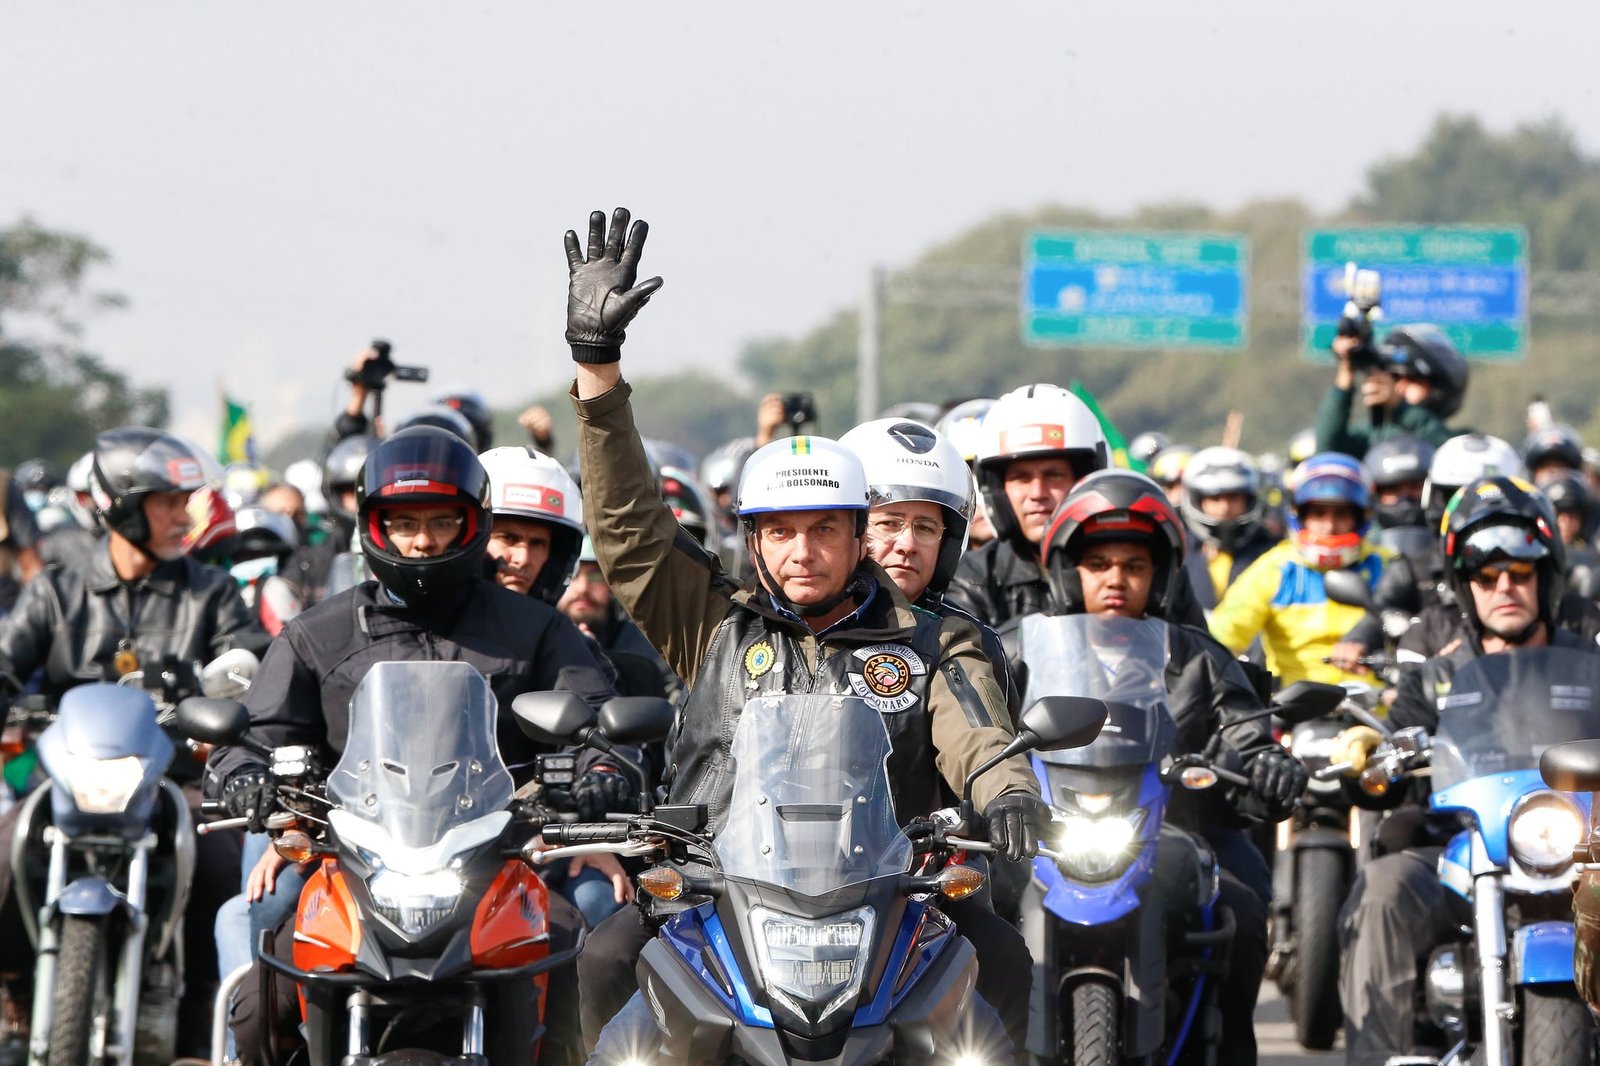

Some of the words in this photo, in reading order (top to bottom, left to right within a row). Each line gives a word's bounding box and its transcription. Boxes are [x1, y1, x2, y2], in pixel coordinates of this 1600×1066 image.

[896, 458, 940, 469] HONDA
[775, 468, 830, 478] PRESIDENTE
[786, 478, 840, 489] BOLSONARO
